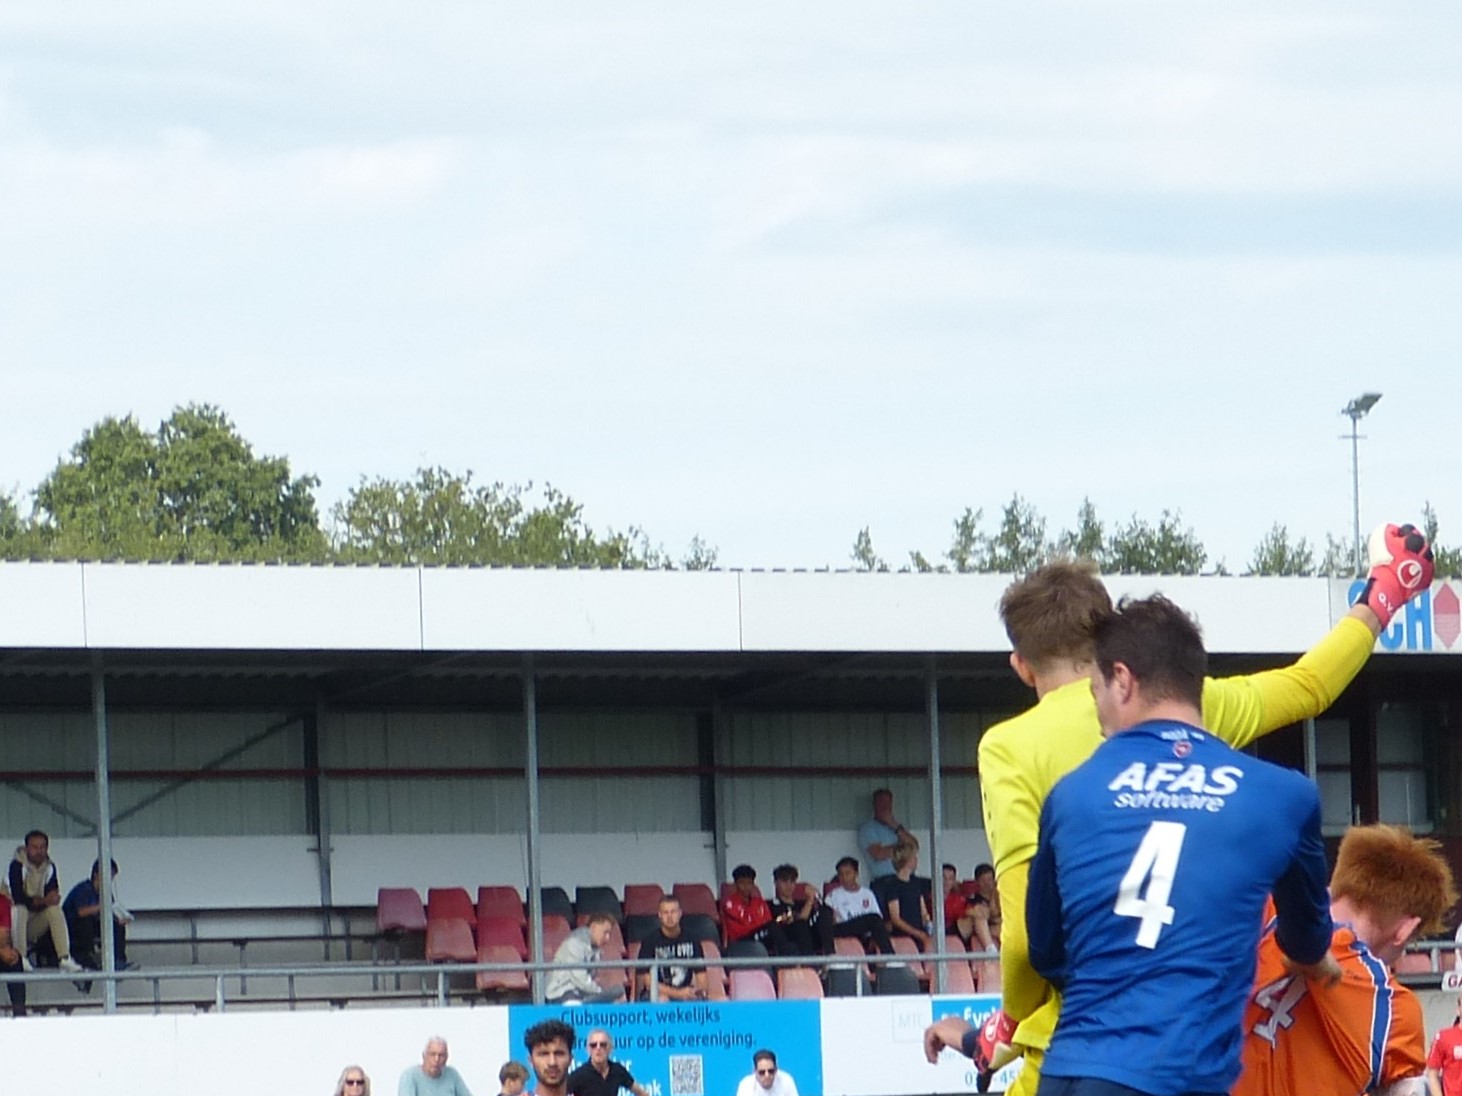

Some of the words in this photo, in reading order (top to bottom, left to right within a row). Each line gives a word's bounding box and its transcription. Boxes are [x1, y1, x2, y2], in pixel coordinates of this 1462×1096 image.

[1107, 760, 1245, 796] AFAS
[1113, 819, 1187, 951] 4
[561, 1007, 653, 1030] Clubsupport,
[656, 1007, 721, 1026] wekelijks
[636, 1034, 656, 1053] op
[658, 1030, 676, 1049] de
[679, 1030, 757, 1050] vereniging.
